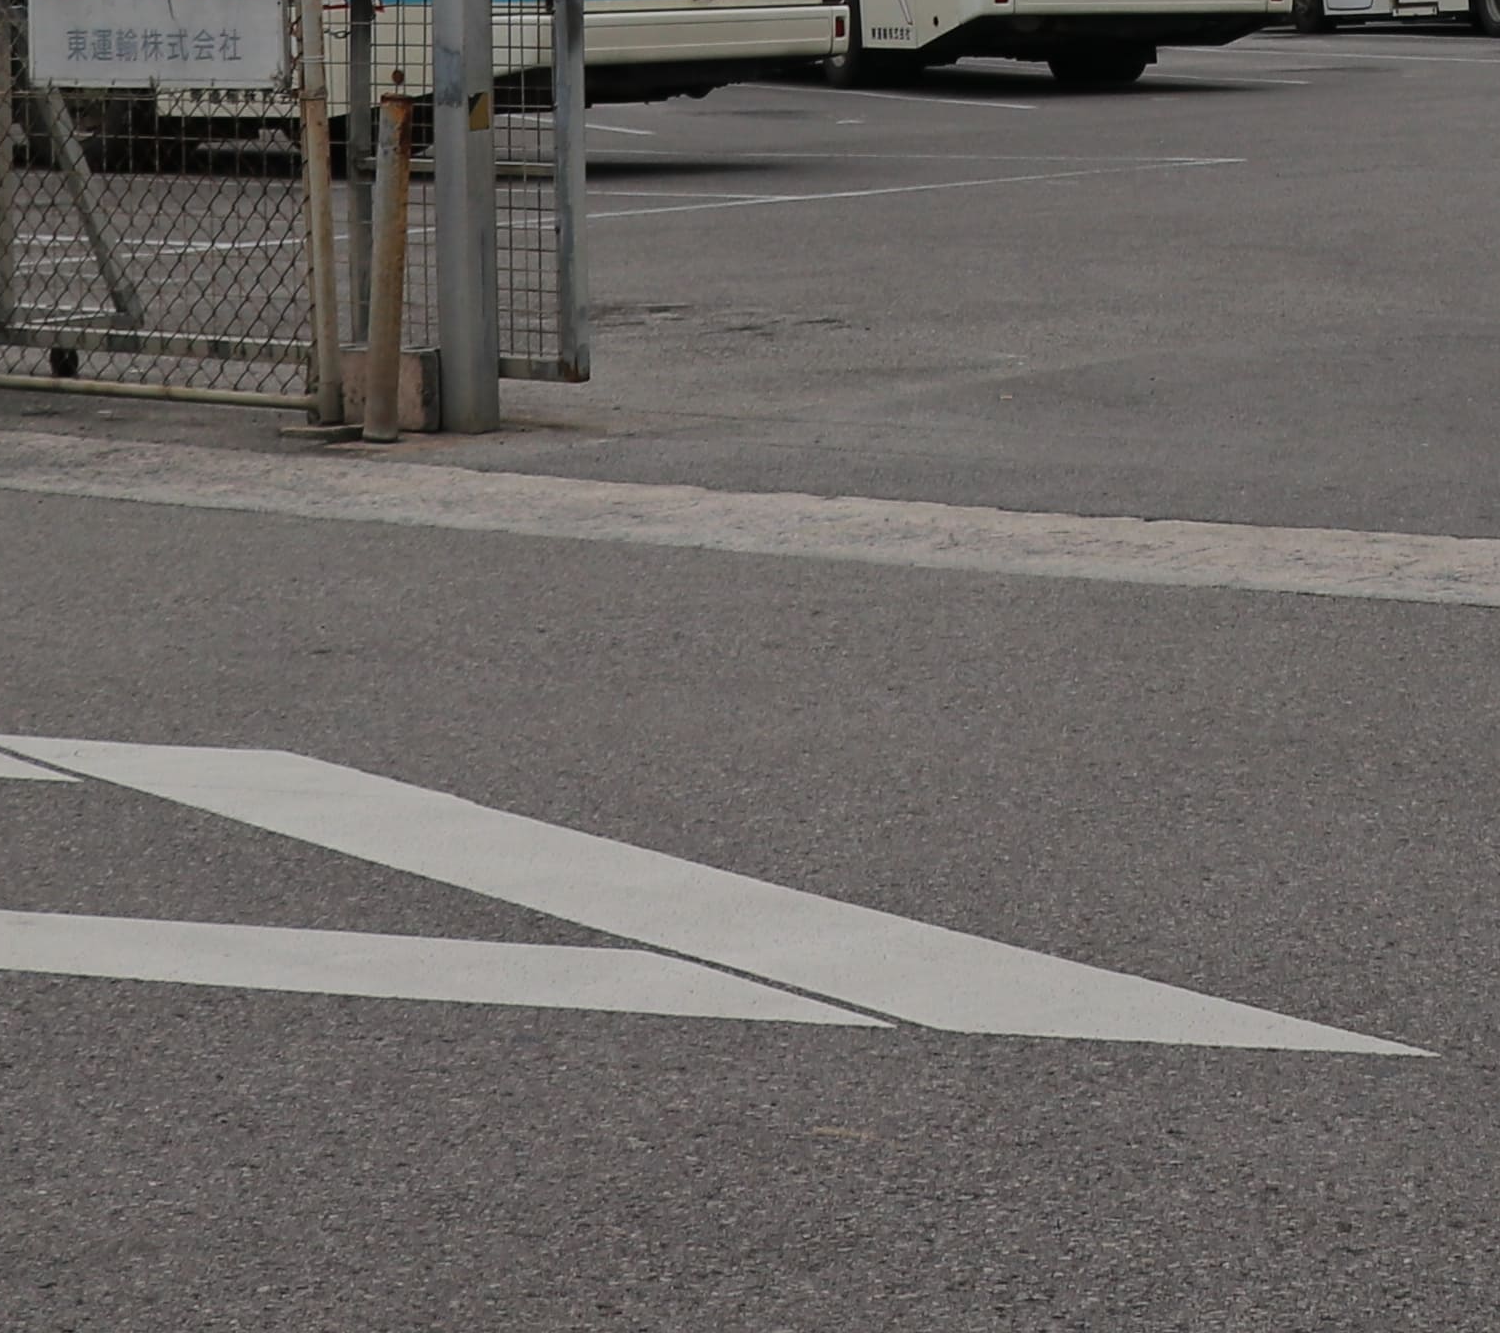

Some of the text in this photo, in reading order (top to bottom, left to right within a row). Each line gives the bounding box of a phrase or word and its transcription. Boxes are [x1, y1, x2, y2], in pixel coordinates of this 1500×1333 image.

[66, 28, 242, 62] 東運輸株式会社
